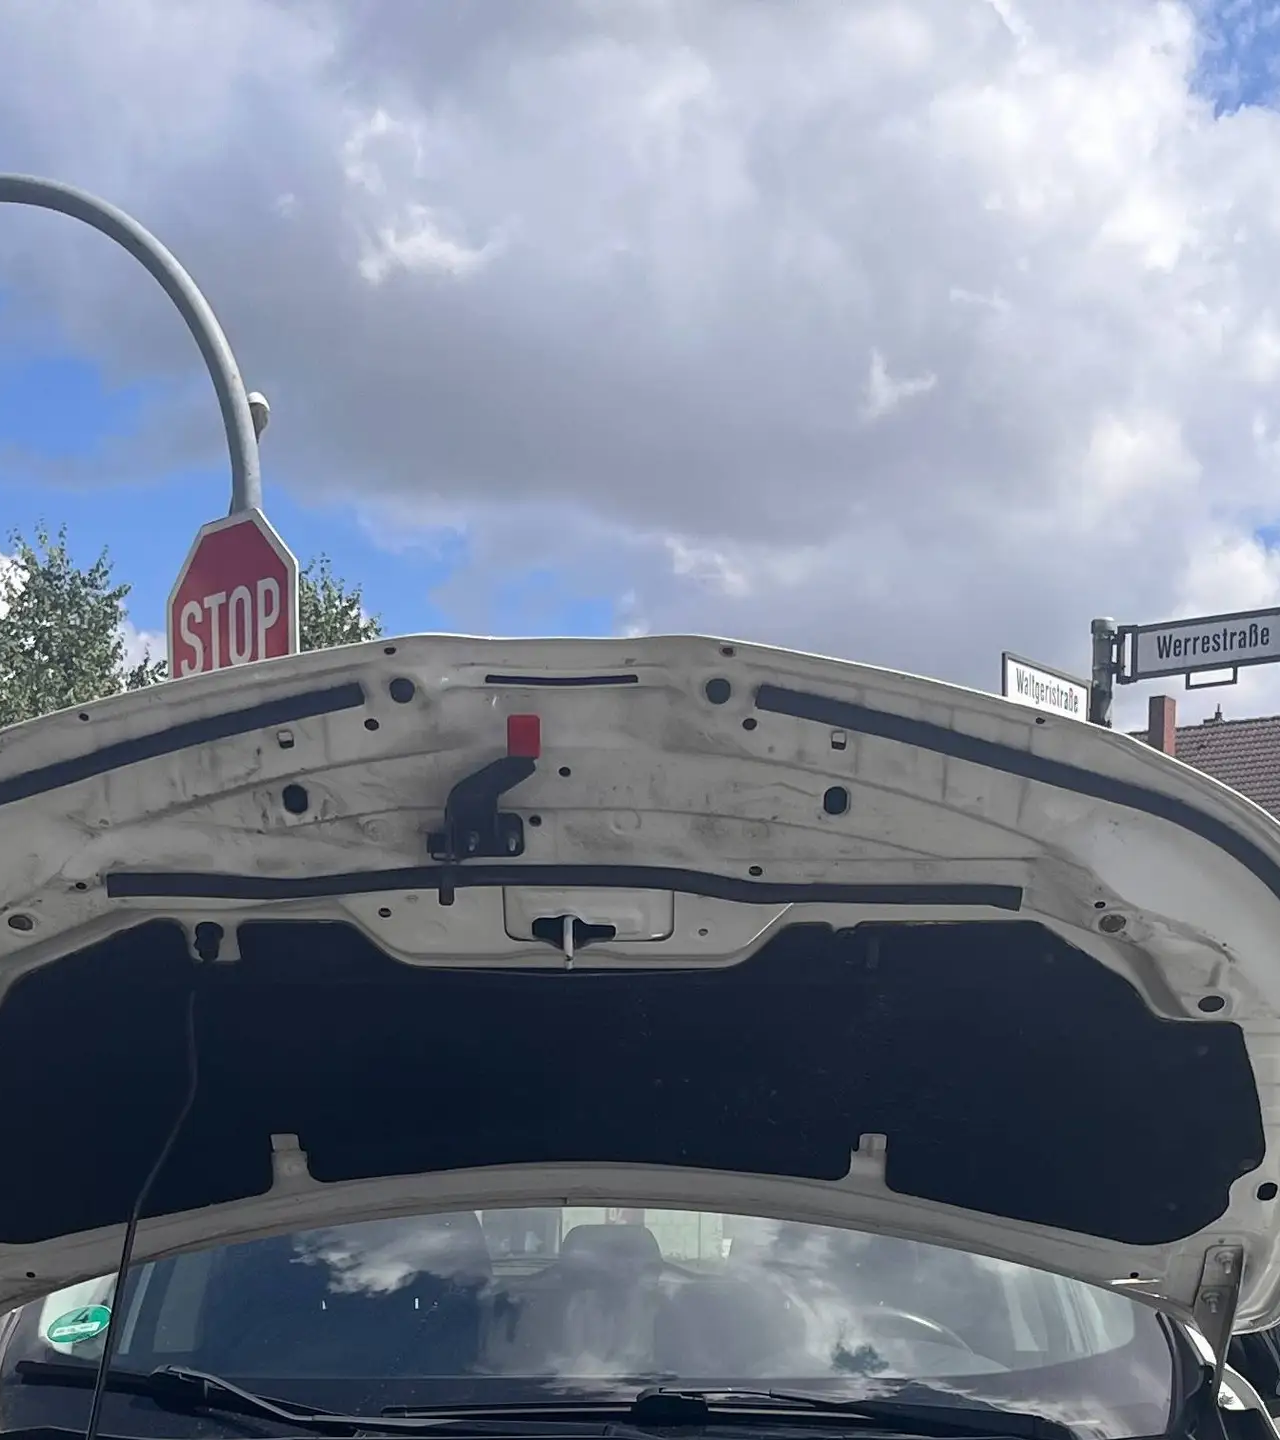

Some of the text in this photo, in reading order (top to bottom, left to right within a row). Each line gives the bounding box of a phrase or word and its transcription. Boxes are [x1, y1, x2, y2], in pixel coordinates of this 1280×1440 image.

[180, 577, 281, 676] STOP
[1156, 623, 1270, 659] Werrestraße
[1016, 667, 1079, 714] Waltgeristraße
[72, 1307, 90, 1323] 4
